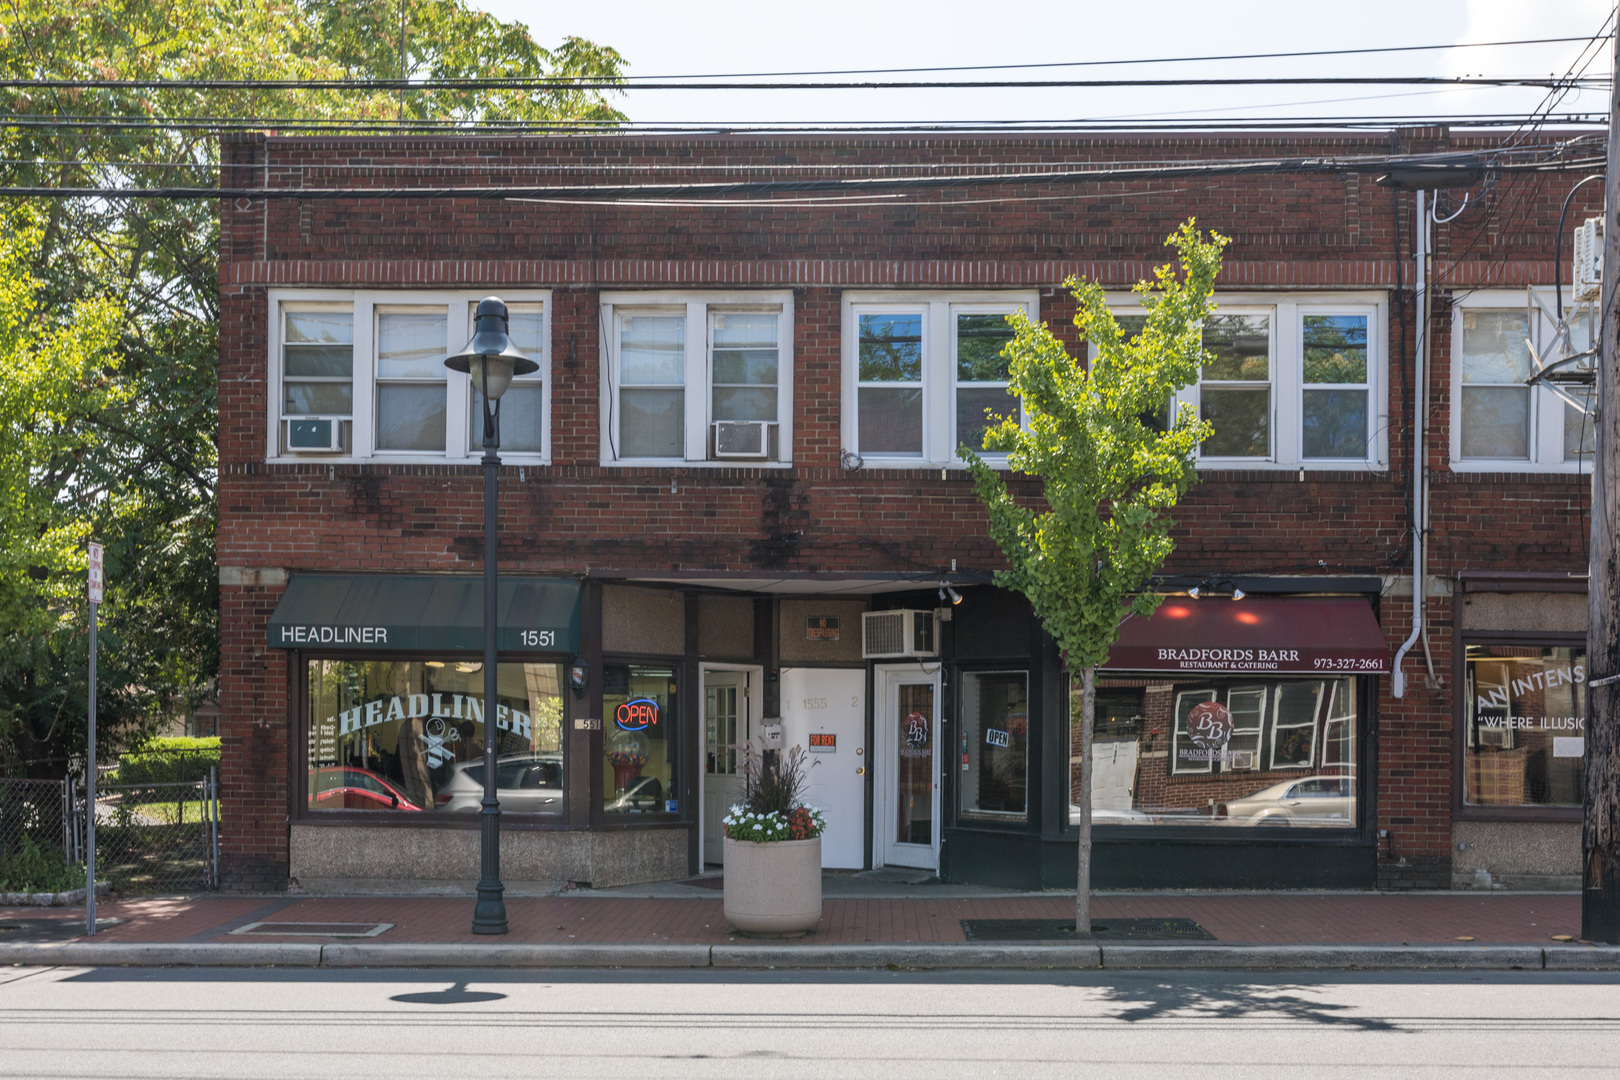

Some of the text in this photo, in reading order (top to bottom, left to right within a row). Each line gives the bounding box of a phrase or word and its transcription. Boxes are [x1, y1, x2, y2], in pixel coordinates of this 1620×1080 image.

[281, 626, 388, 643] HEADLINER
[520, 630, 555, 646] 1551
[808, 627, 839, 638] TRESPASSING
[1157, 648, 1300, 661] BRADFORDS BARR
[1180, 661, 1278, 670] RESTAURANT & CATERING
[1313, 658, 1383, 669] 973-327-2661
[803, 697, 828, 710] 1555
[851, 696, 859, 708] 2
[1477, 686, 1507, 714] AN
[339, 693, 532, 741] HEADLINER
[617, 704, 658, 725] OPEN
[810, 734, 835, 746] FOR RENT
[988, 730, 1008, 746] OPEN
